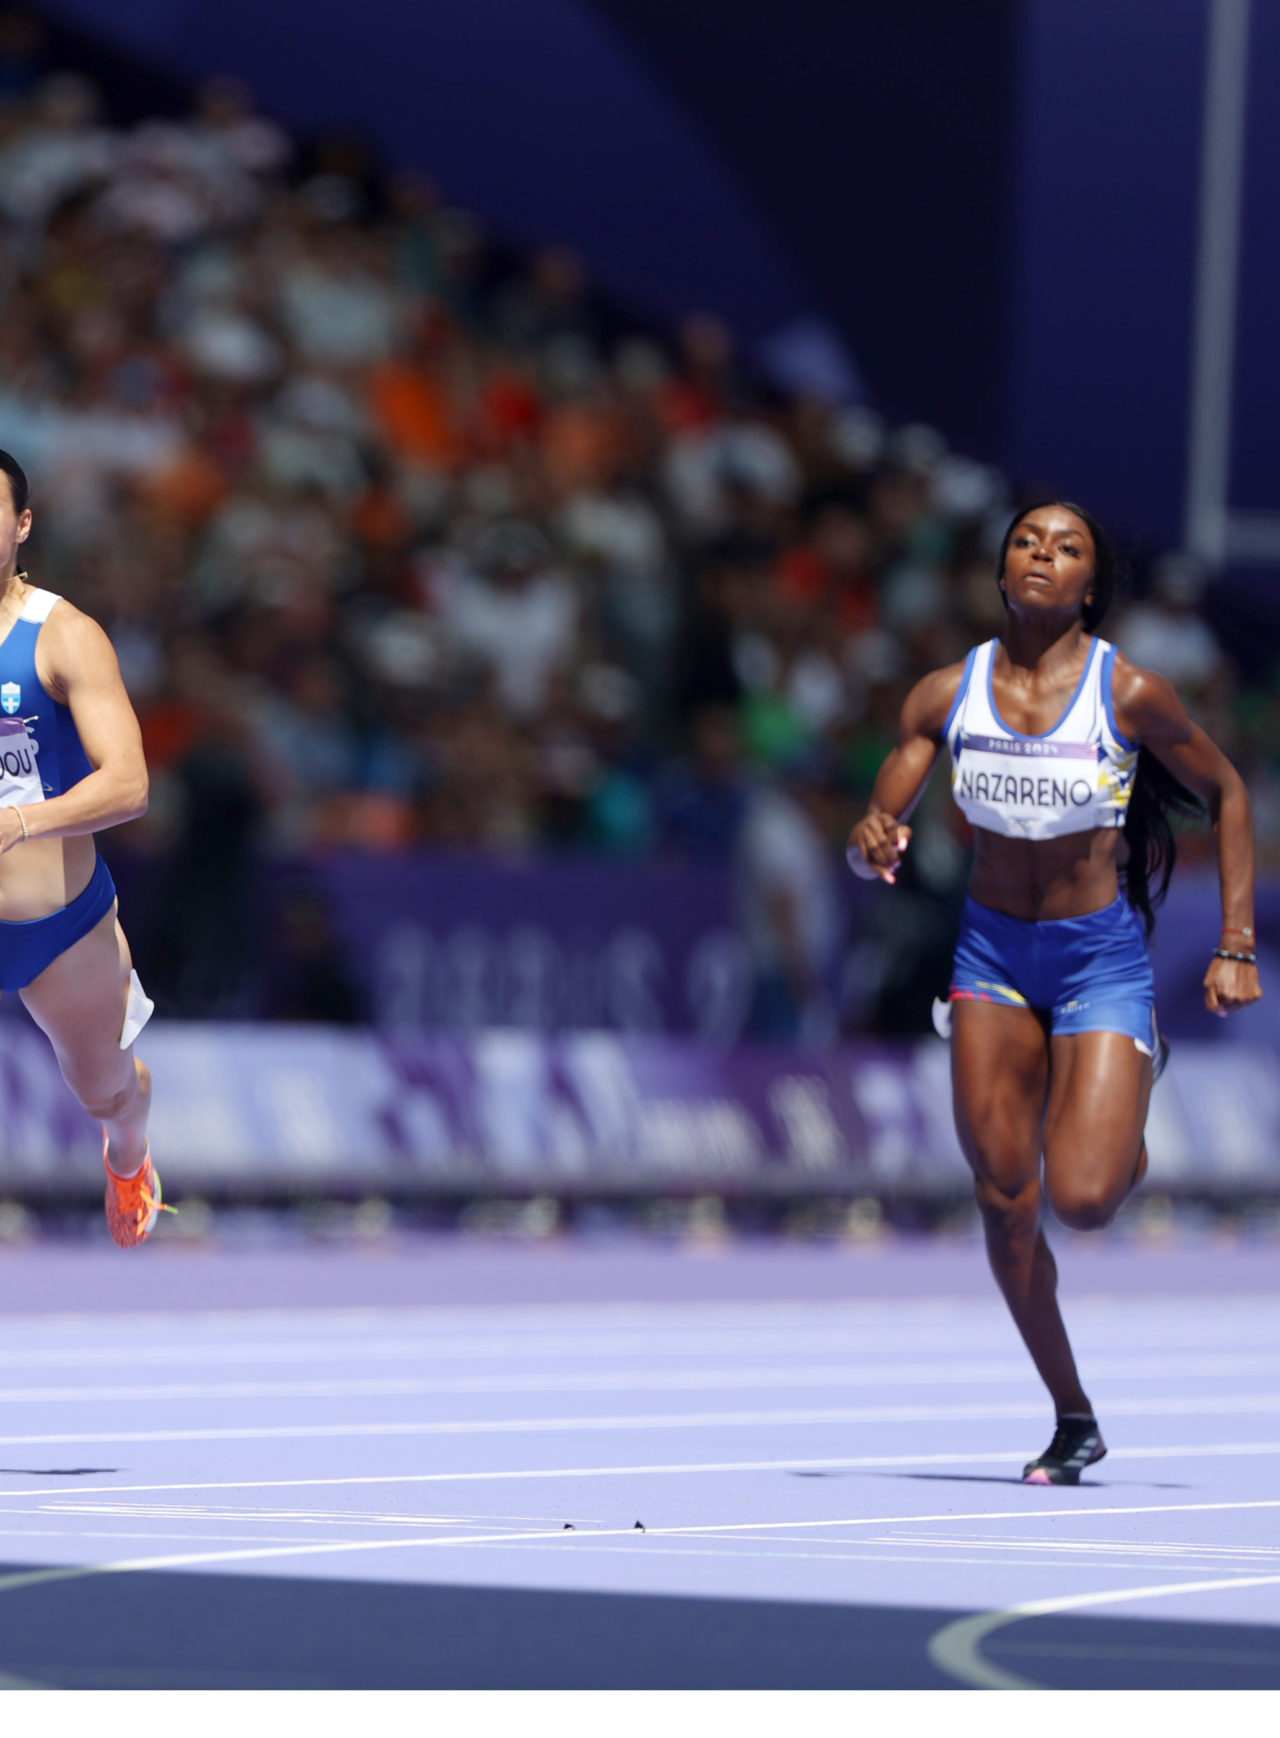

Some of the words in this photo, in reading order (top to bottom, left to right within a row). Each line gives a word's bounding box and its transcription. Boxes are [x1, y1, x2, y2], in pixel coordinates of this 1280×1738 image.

[988, 739, 1020, 753] PARIS
[1024, 742, 1058, 754] 2024
[960, 769, 1092, 807] NAZARENO
